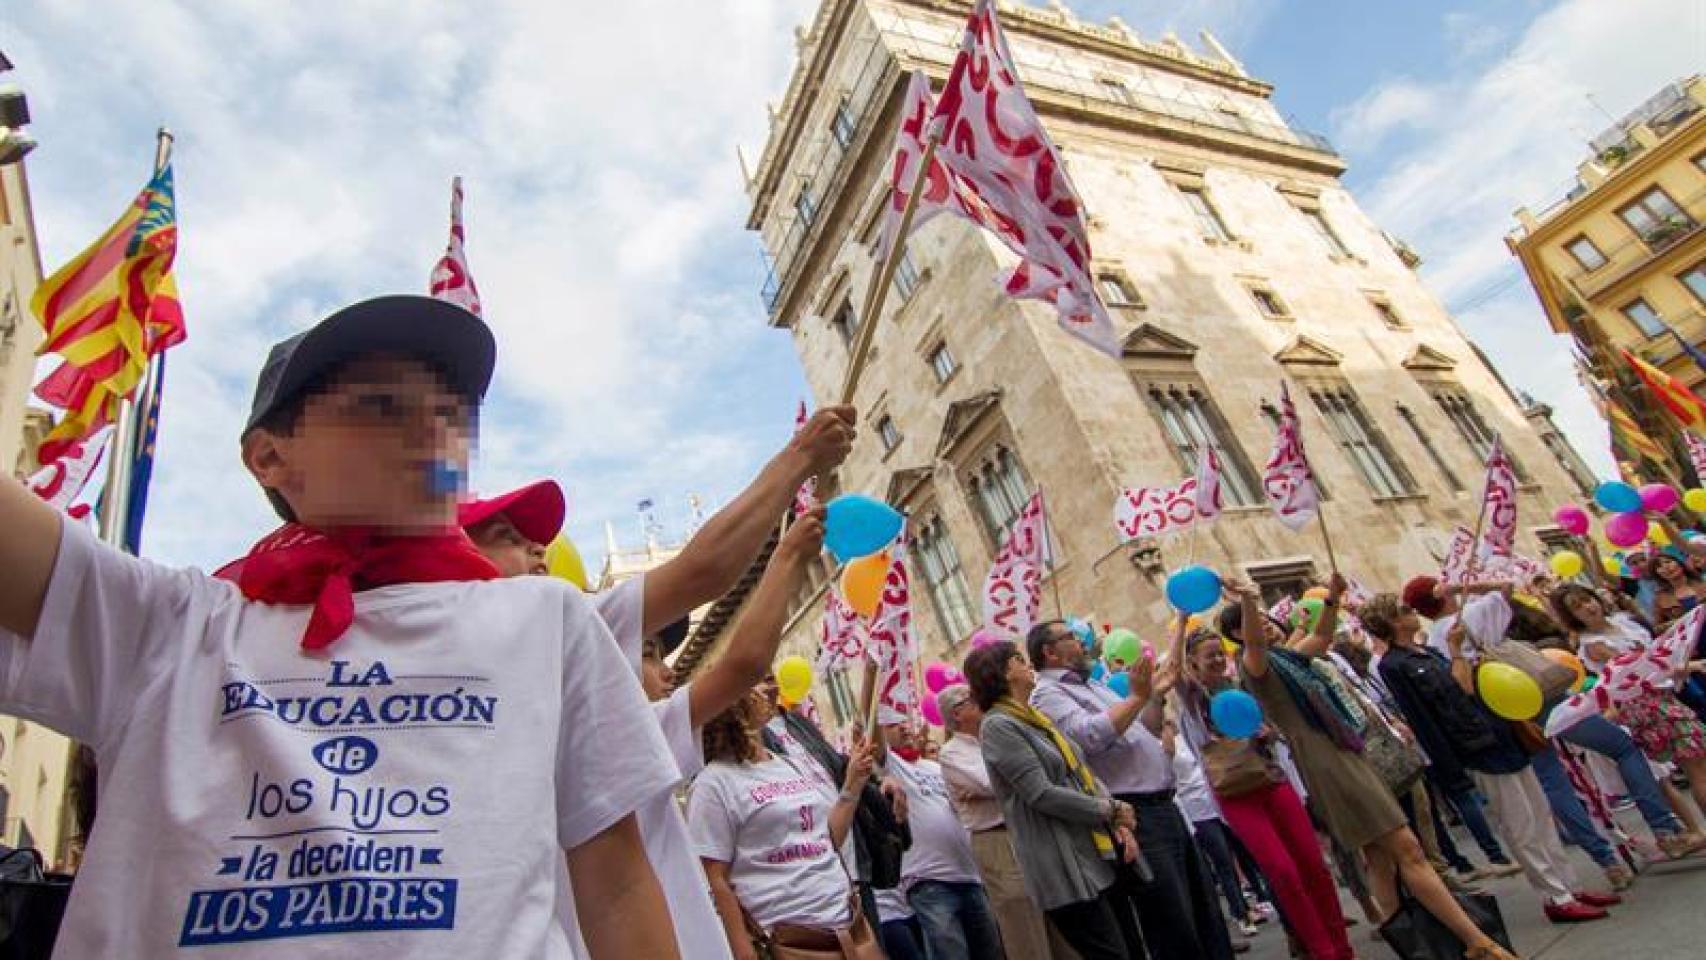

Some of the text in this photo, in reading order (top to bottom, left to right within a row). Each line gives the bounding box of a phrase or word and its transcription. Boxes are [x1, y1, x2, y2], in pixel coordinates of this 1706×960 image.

[326, 660, 393, 688] LA
[321, 740, 368, 770] de
[246, 771, 451, 831] los hijos
[244, 837, 415, 882] la deciden
[188, 880, 445, 936] LOS PADRES
